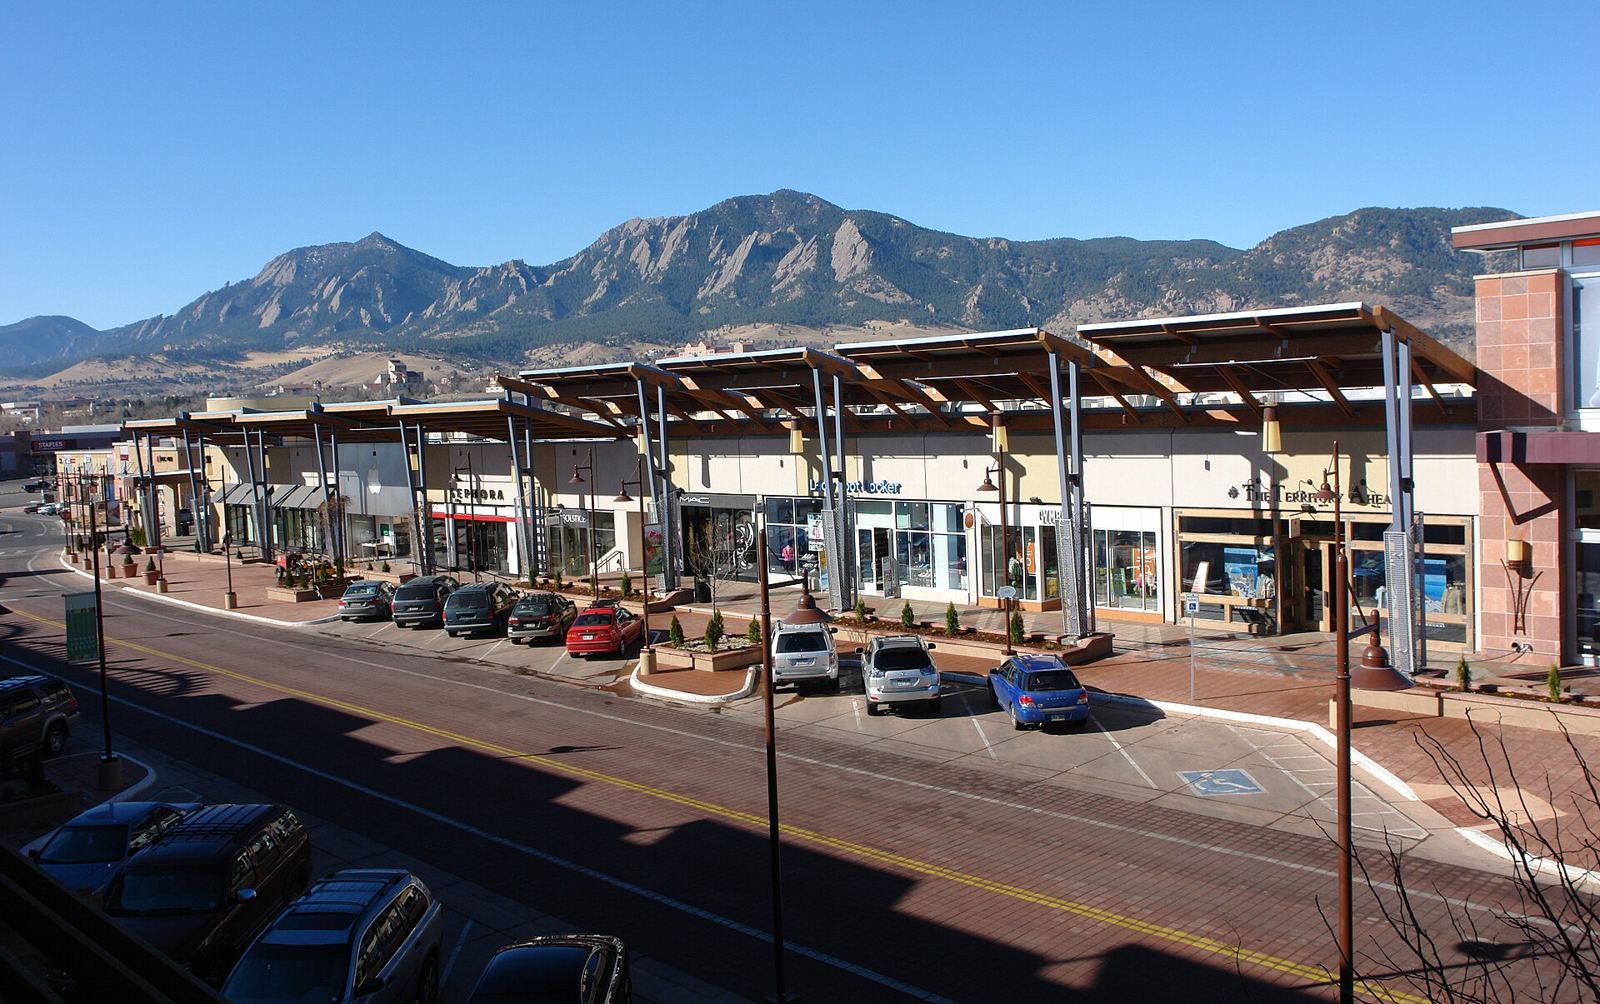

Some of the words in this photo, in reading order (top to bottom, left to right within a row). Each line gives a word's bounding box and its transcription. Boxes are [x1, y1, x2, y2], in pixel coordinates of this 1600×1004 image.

[38, 441, 63, 449] STAPLES
[863, 480, 902, 494] Locker
[450, 488, 505, 501] SEPHORA
[1242, 484, 1271, 502] THE
[1349, 485, 1393, 506] AHEA
